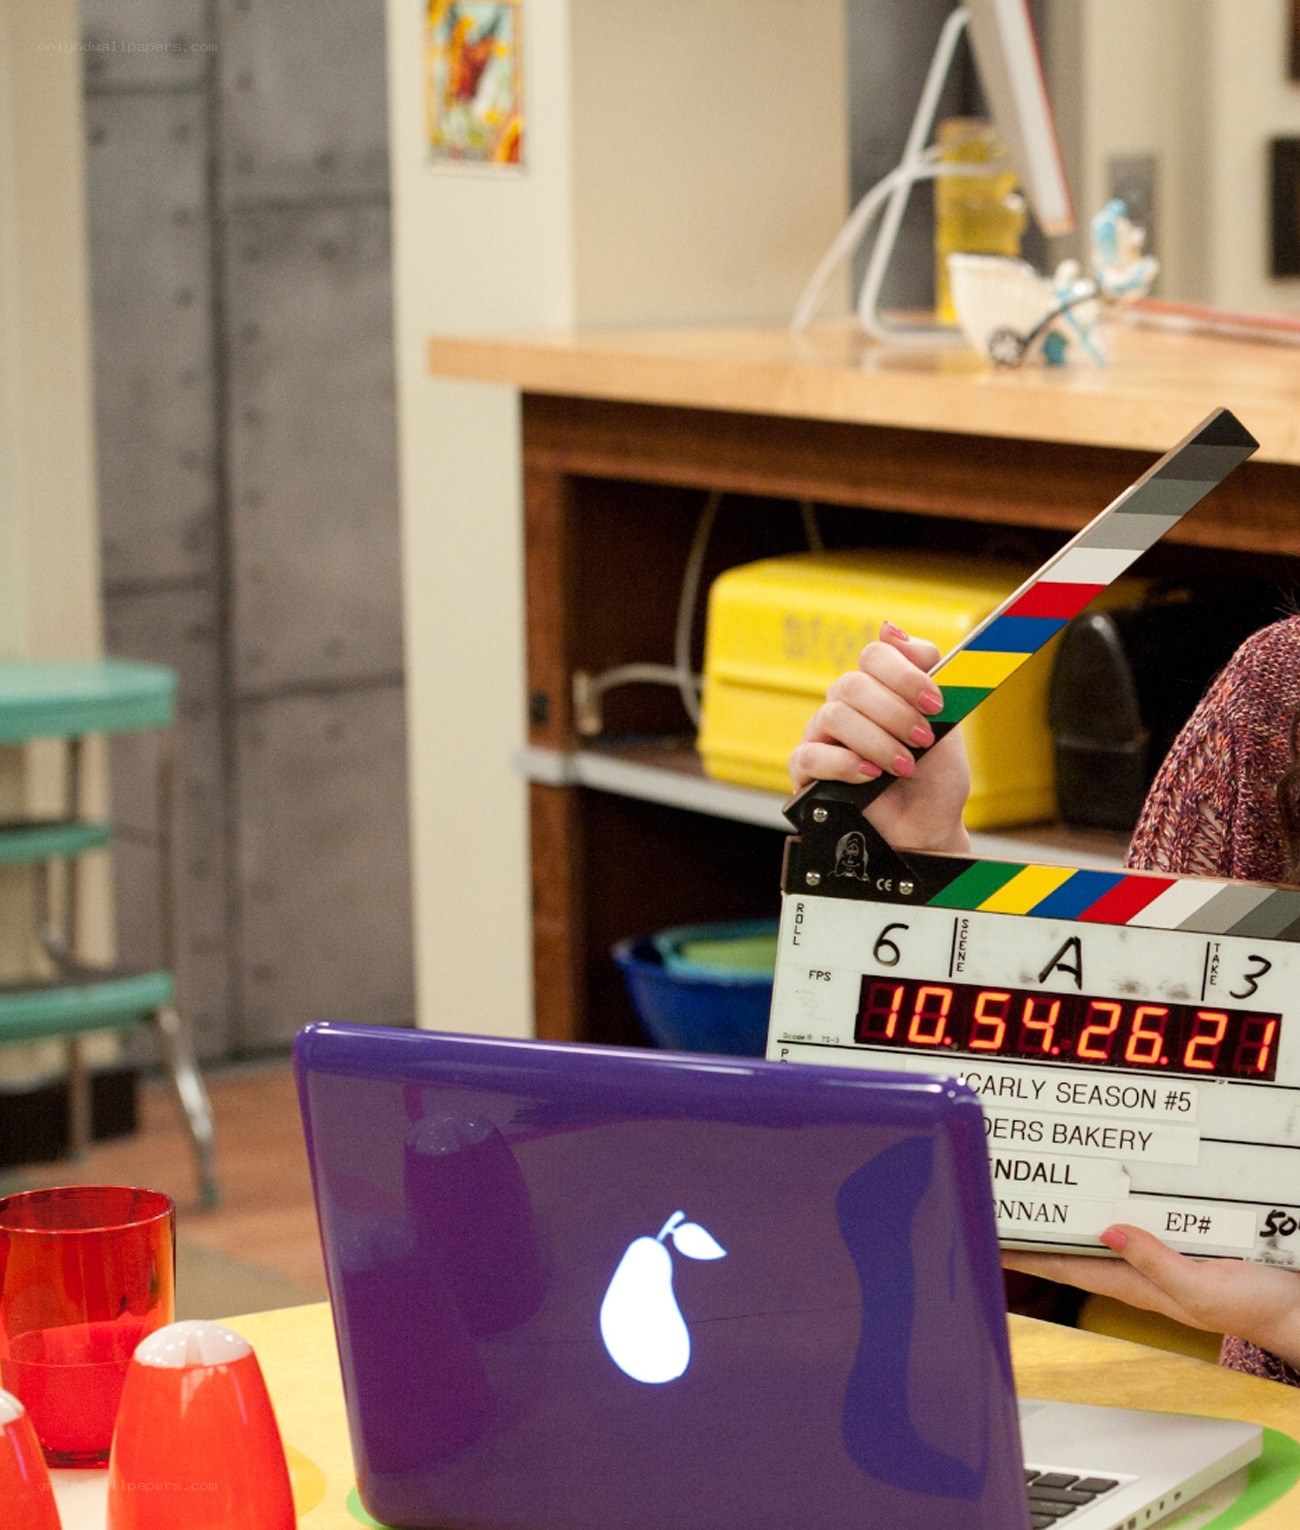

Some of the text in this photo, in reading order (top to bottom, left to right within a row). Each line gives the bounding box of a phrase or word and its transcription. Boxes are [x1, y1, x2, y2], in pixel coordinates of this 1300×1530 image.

[793, 902, 805, 945] ROLL
[873, 922, 909, 967] 6
[956, 919, 969, 972] SCENE
[1038, 936, 1083, 990] A
[1210, 943, 1221, 986] TAKE
[809, 970, 831, 981] FPS
[1229, 954, 1272, 999] 3
[960, 1072, 1192, 1112] CARLY SEASON #5
[1052, 1123, 1153, 1151] BAKERY
[989, 1158, 1078, 1185] NDALL
[994, 1199, 1069, 1224] NNAN
[1165, 1212, 1211, 1234] EP#
